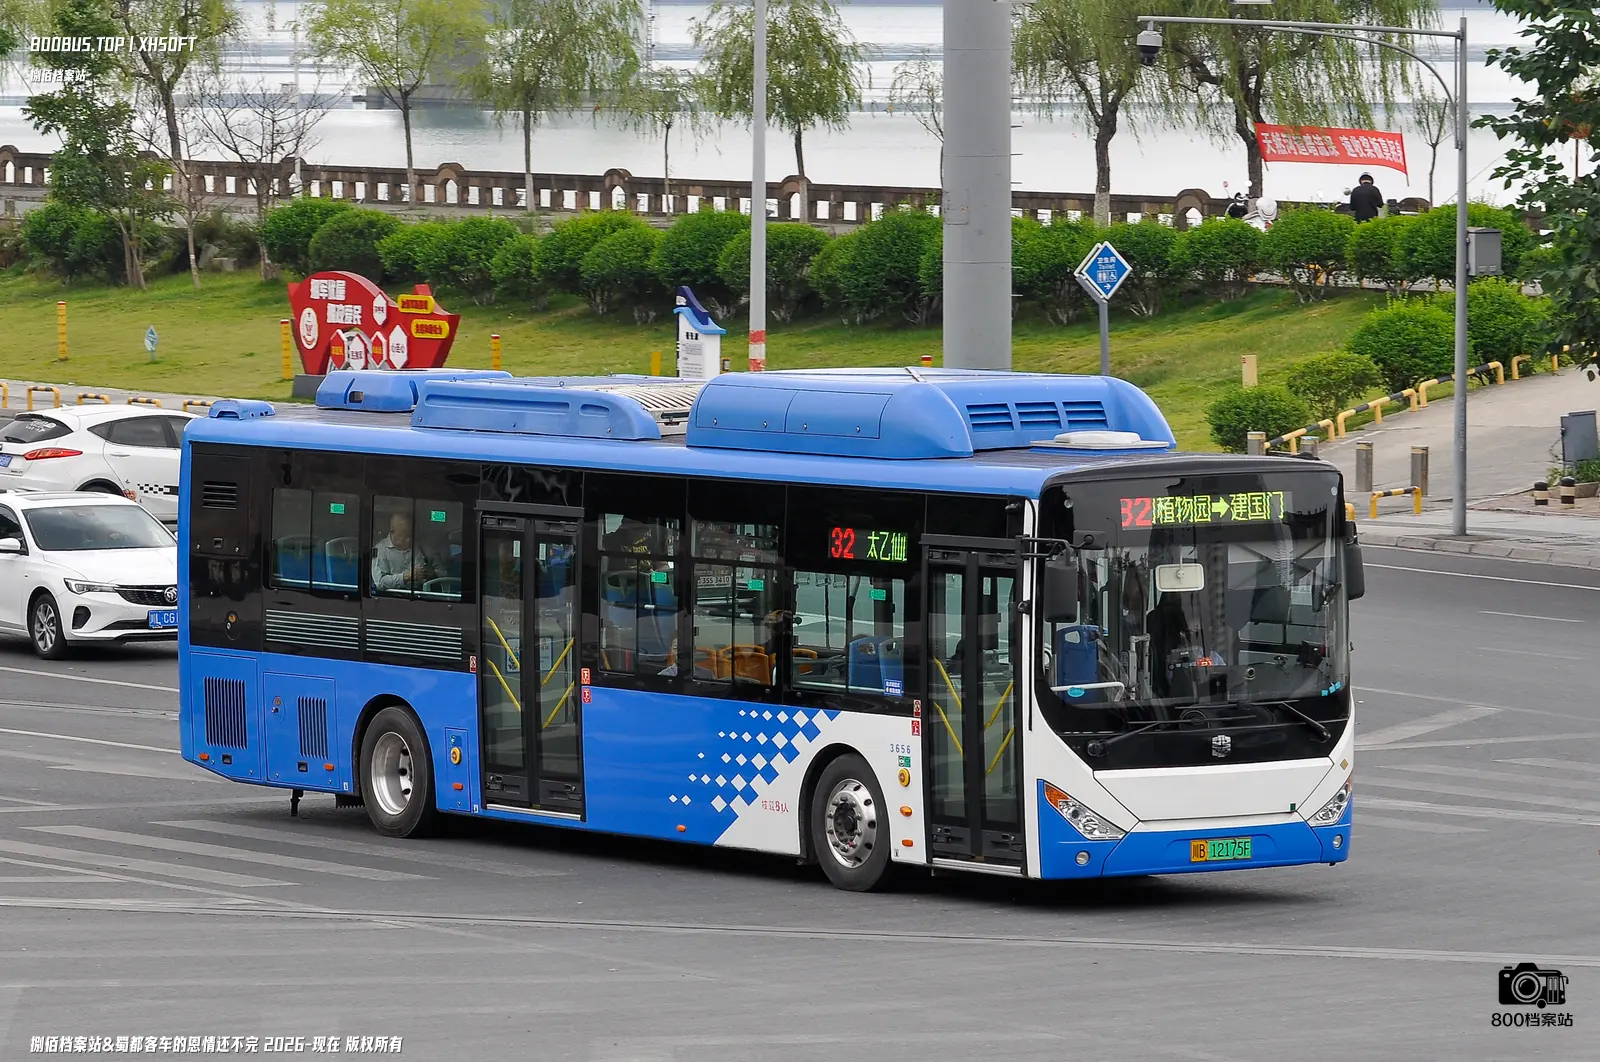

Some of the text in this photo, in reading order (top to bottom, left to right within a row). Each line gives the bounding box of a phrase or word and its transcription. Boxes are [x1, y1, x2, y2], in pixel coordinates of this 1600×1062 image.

[1229, 491, 1284, 521] 建国门
[831, 527, 855, 559] 32
[866, 531, 908, 562] 太乙仙
[889, 743, 911, 754] 3656
